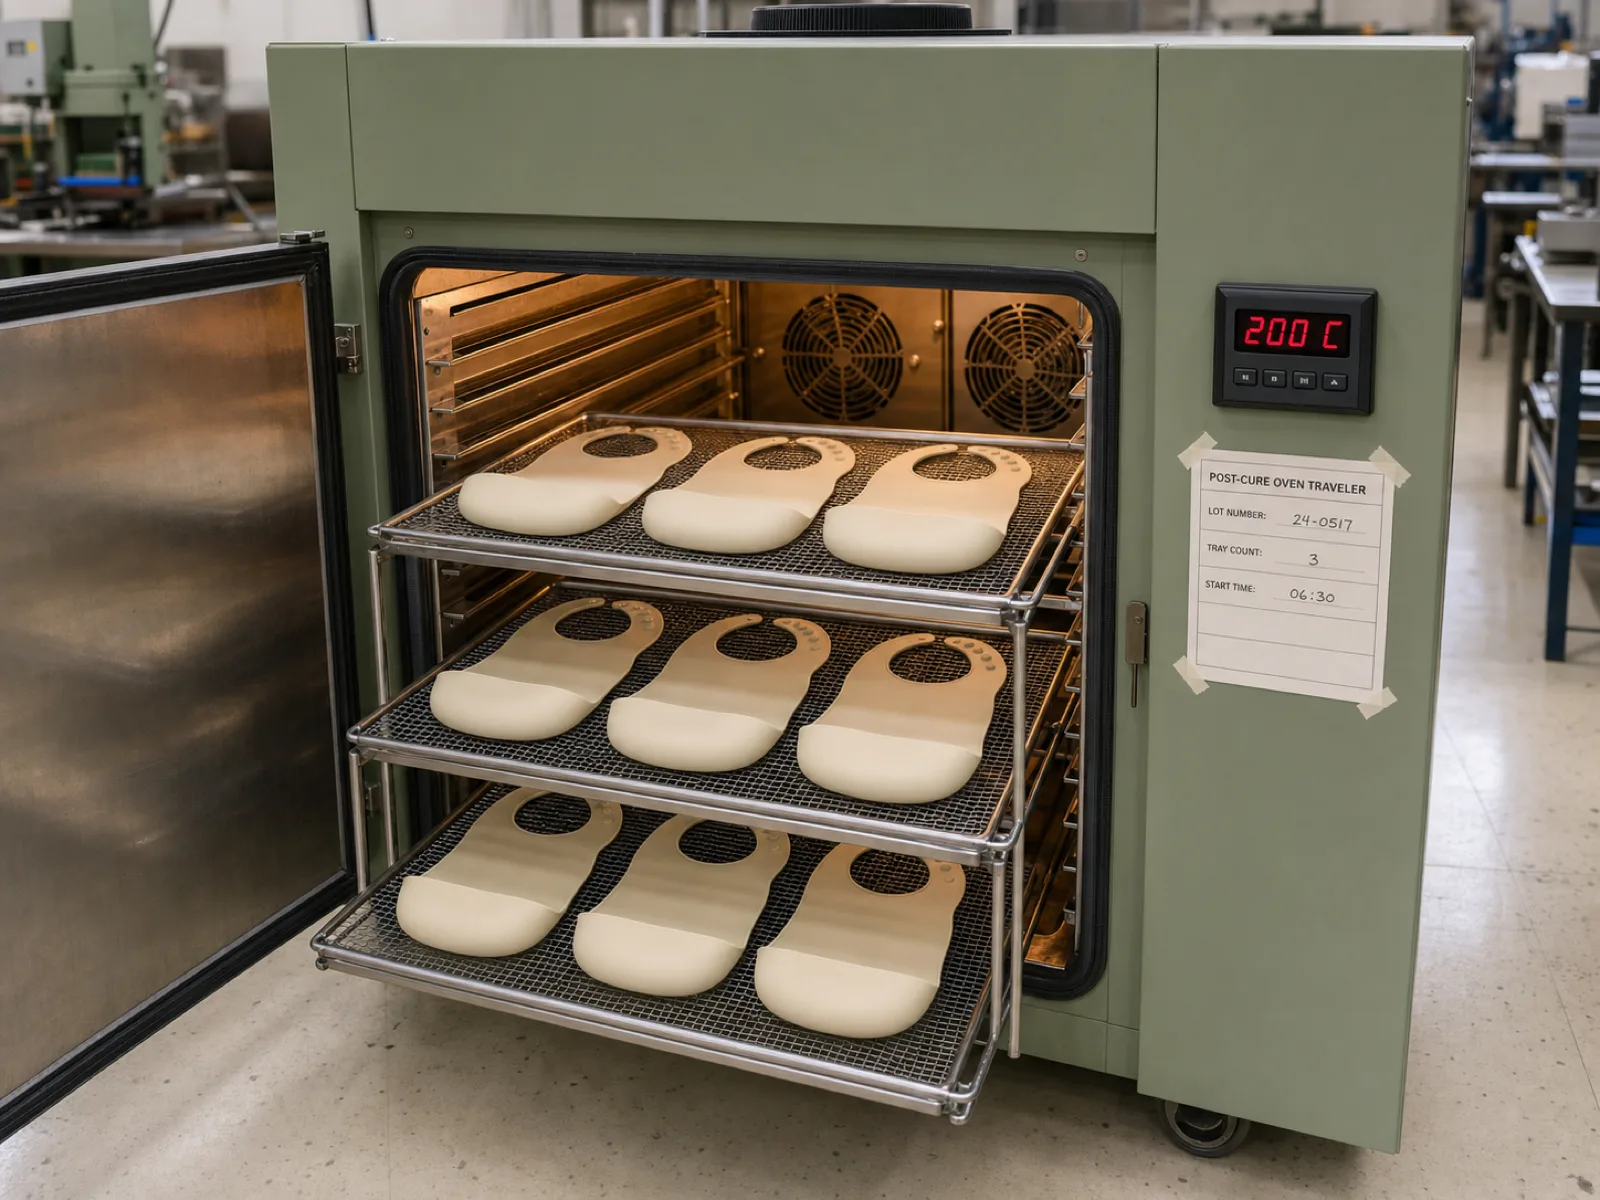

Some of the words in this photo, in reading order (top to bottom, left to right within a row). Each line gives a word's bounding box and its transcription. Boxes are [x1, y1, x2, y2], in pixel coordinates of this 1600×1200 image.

[1244, 316, 1309, 348] 200
[1322, 320, 1344, 350] C
[1209, 472, 1270, 487] POST-CURE
[1273, 477, 1304, 490] OVEN
[1308, 480, 1367, 495] TRAVELER
[1208, 507, 1225, 517] LOT
[1226, 509, 1267, 520] NUMBER:
[1292, 514, 1354, 531] 24-0517
[1207, 544, 1228, 554] TRAY
[1230, 546, 1262, 557] COUNT:
[1308, 553, 1319, 566] 3
[1205, 580, 1231, 591] START
[1233, 583, 1256, 593] TIME:
[1290, 588, 1335, 603] 06:30
